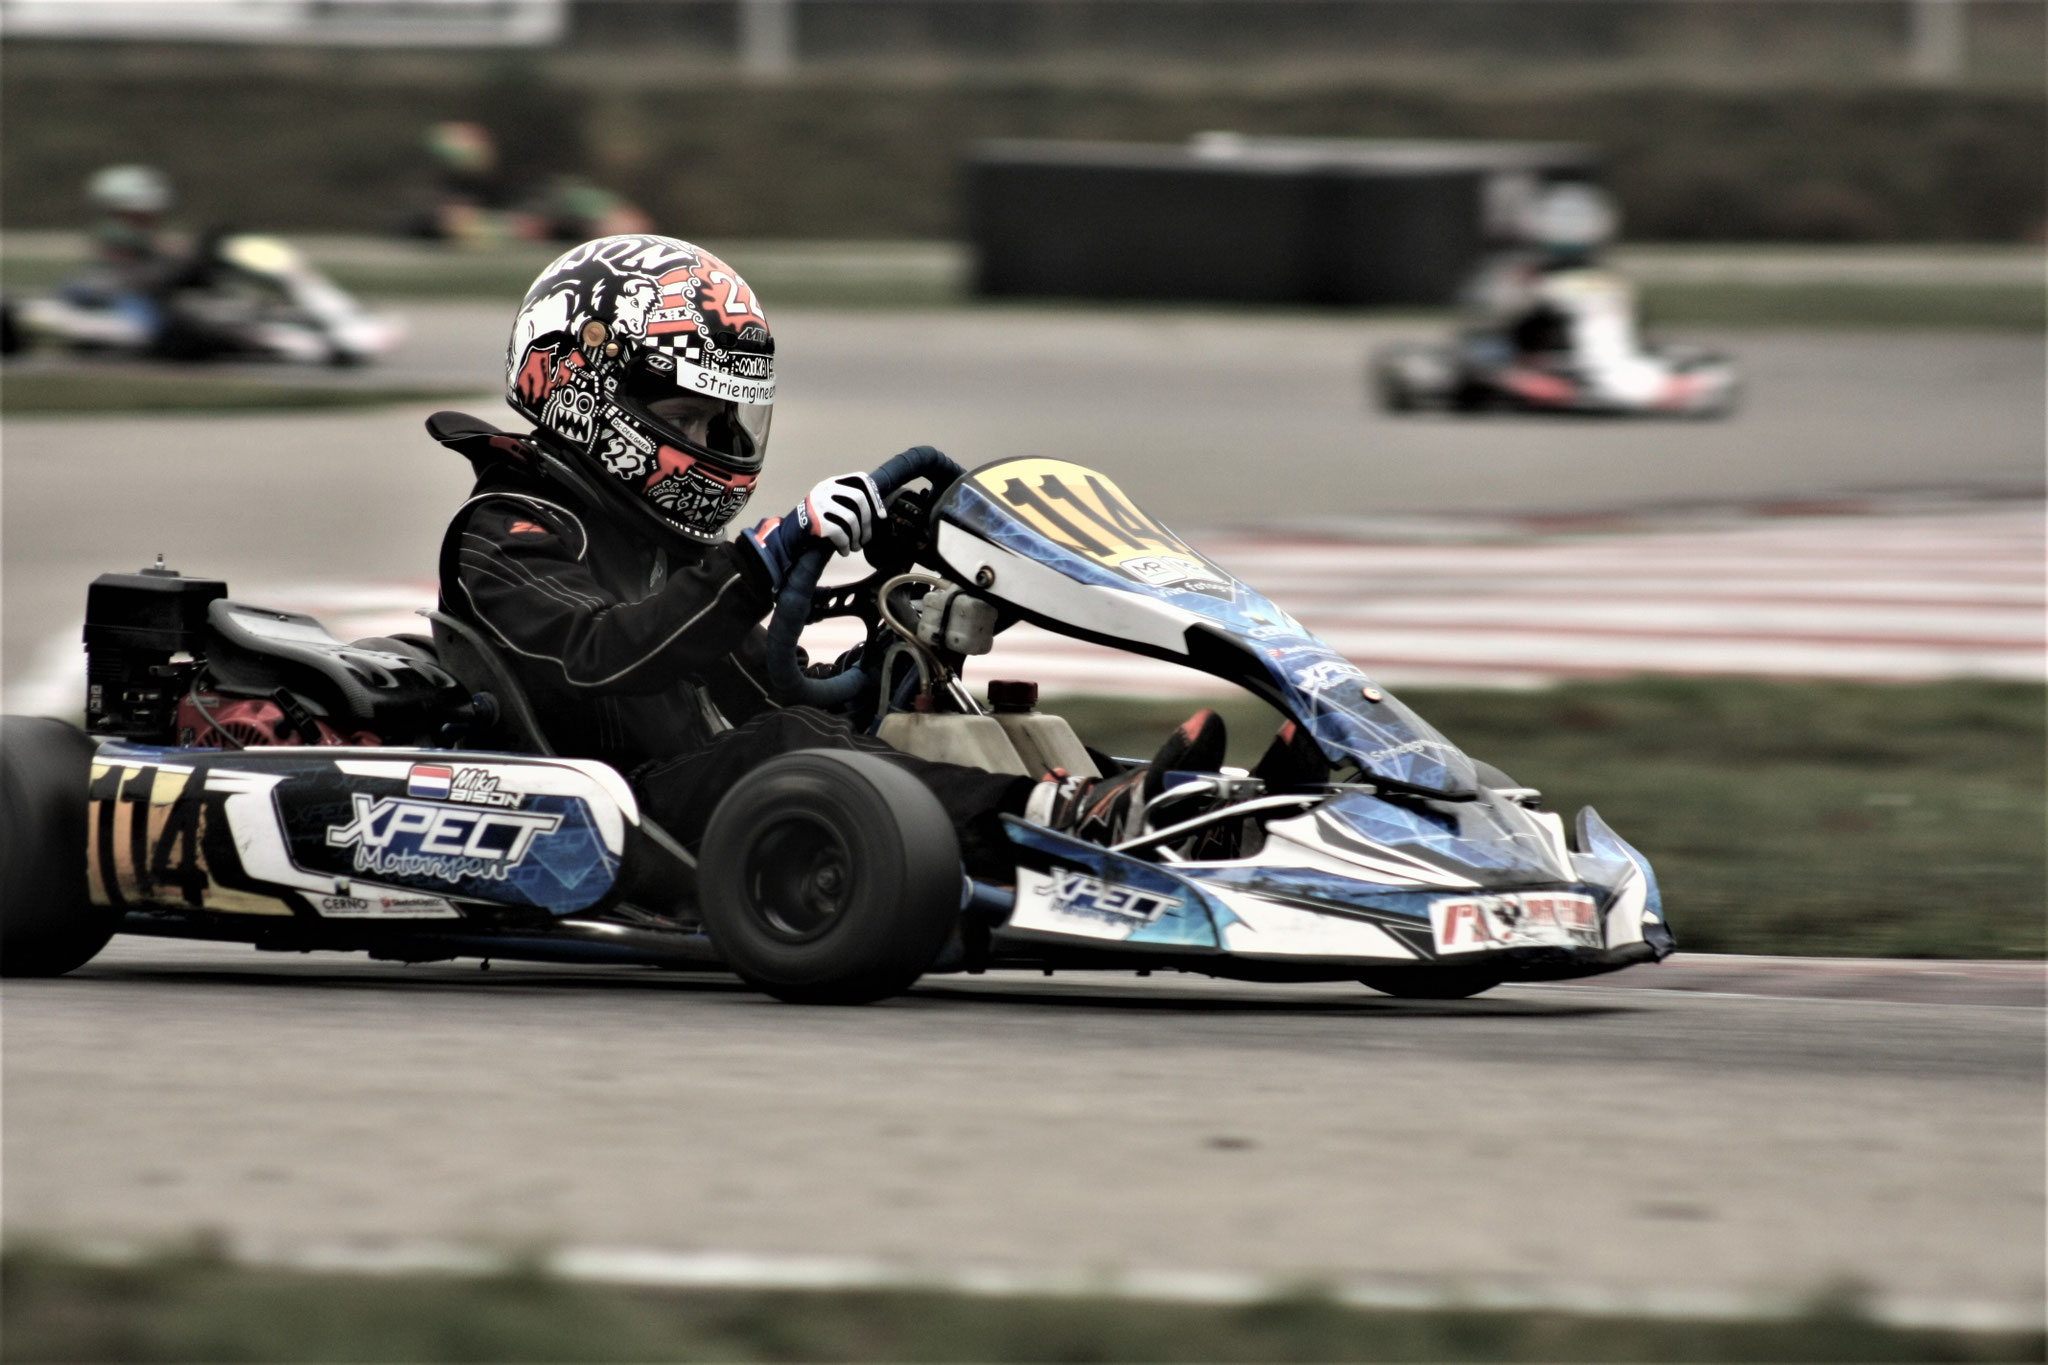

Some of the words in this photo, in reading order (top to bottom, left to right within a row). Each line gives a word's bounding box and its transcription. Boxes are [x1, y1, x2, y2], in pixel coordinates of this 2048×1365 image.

[604, 441, 641, 477] 22
[1001, 474, 1189, 557] 114
[449, 788, 525, 810] BISON
[452, 767, 500, 793] Mika
[88, 764, 210, 907] 114
[326, 792, 564, 868] XPECT
[353, 842, 512, 884] Motorsport
[321, 897, 369, 910] CERNO
[1034, 866, 1184, 922] XPECT
